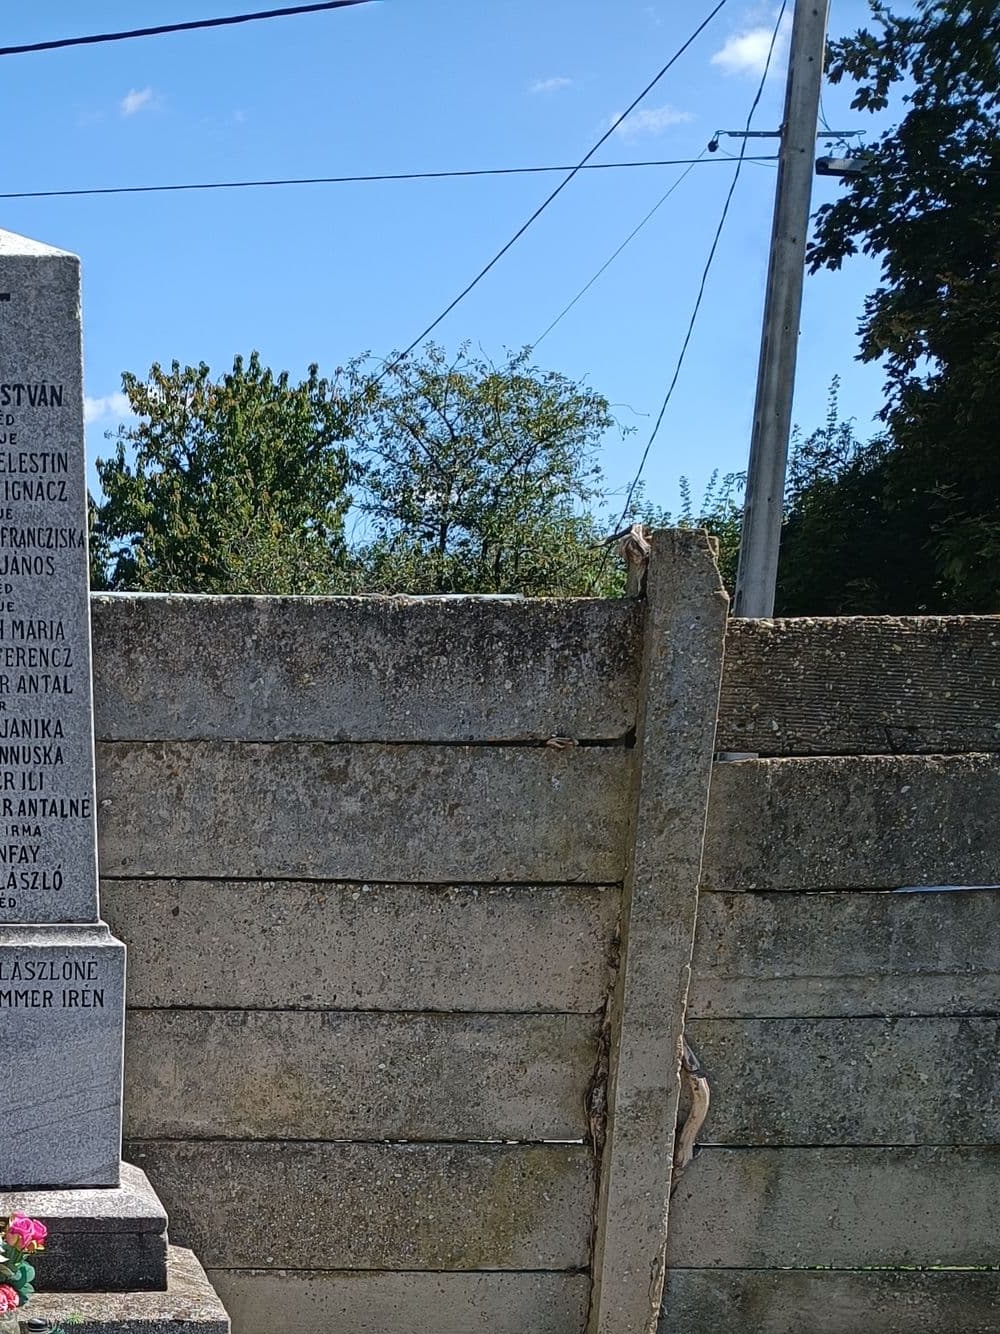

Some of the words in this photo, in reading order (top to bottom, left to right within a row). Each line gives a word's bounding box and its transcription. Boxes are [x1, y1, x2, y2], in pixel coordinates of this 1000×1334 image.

[4, 476, 68, 501] IGNÁCZ
[1, 528, 85, 549] FRANCZISKA
[0, 551, 56, 576] JÁNOS
[12, 615, 66, 641] MÁRIA
[16, 674, 74, 694] ANTAL
[17, 792, 91, 819] ANTALNÉ
[6, 825, 42, 838] IRMA
[62, 984, 105, 1009] IRÉN
